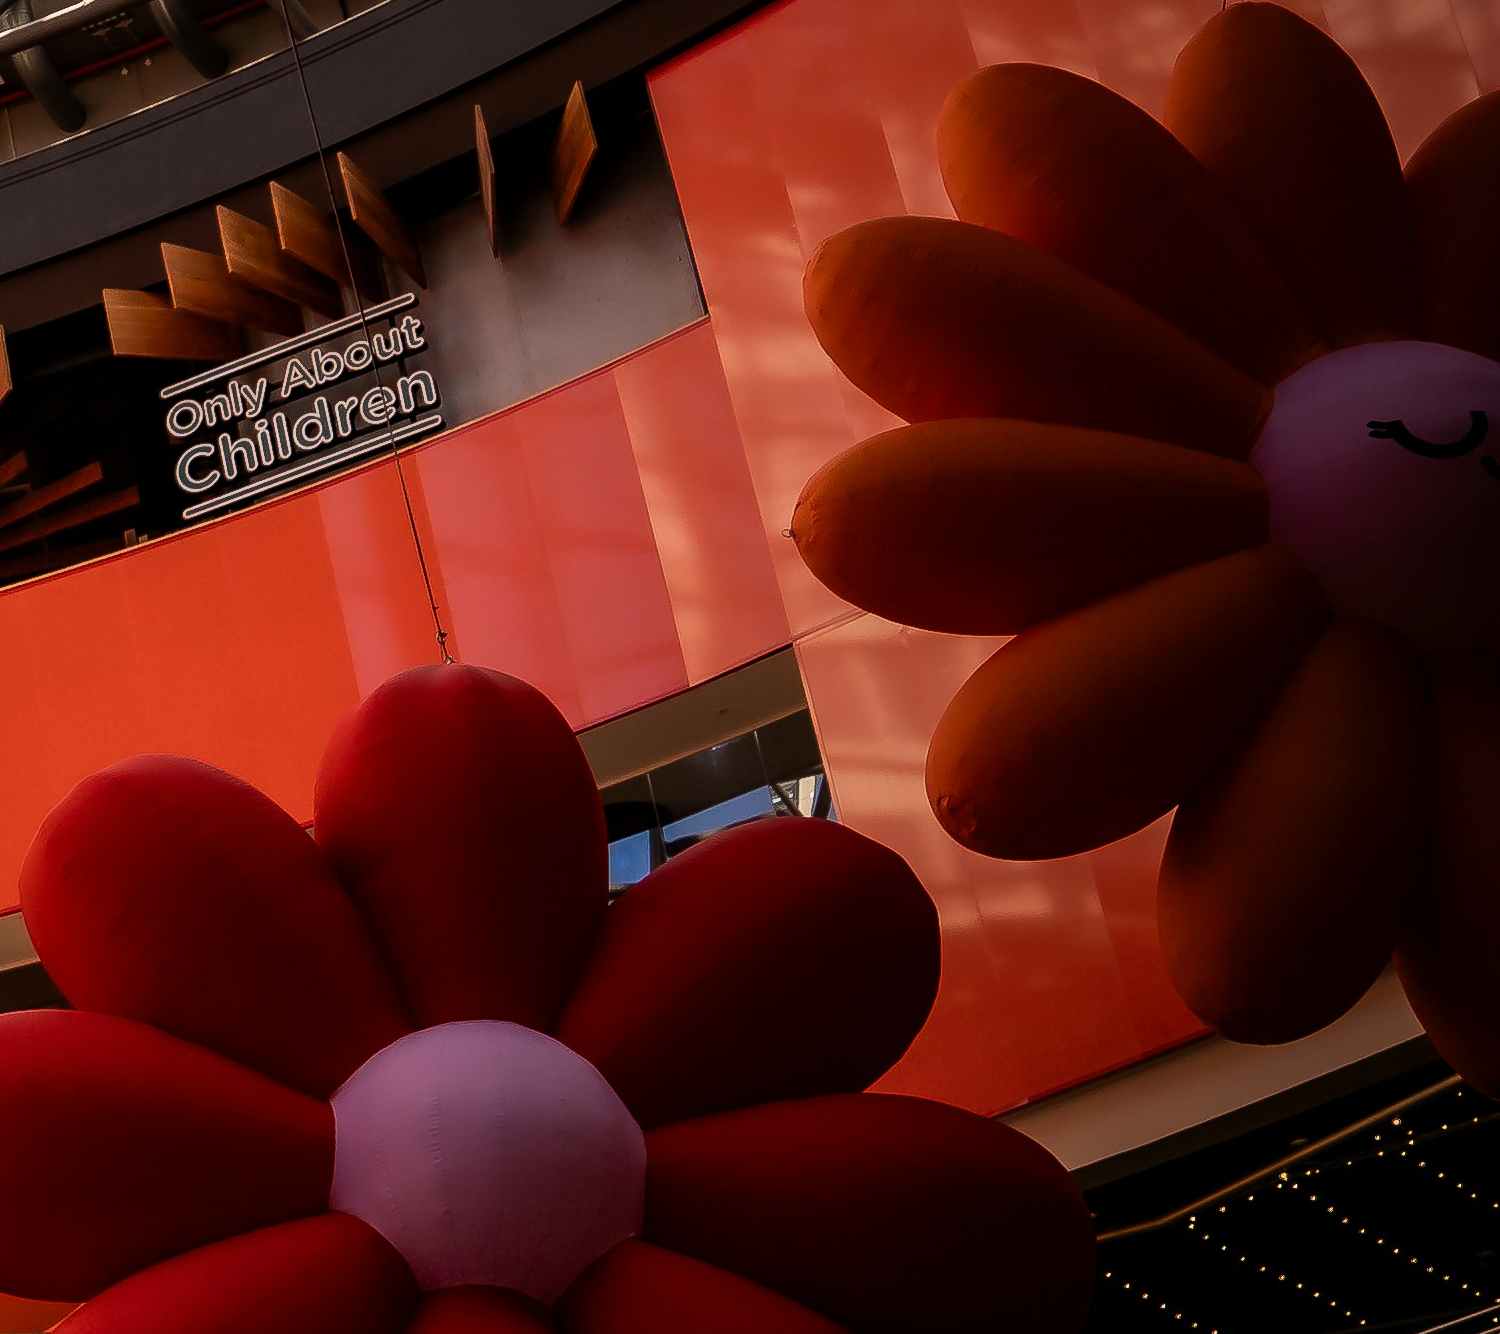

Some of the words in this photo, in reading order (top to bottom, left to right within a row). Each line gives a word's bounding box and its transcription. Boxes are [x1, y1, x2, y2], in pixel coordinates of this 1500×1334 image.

[166, 376, 266, 438] Only
[281, 315, 425, 398] About
[175, 369, 438, 494] Children
